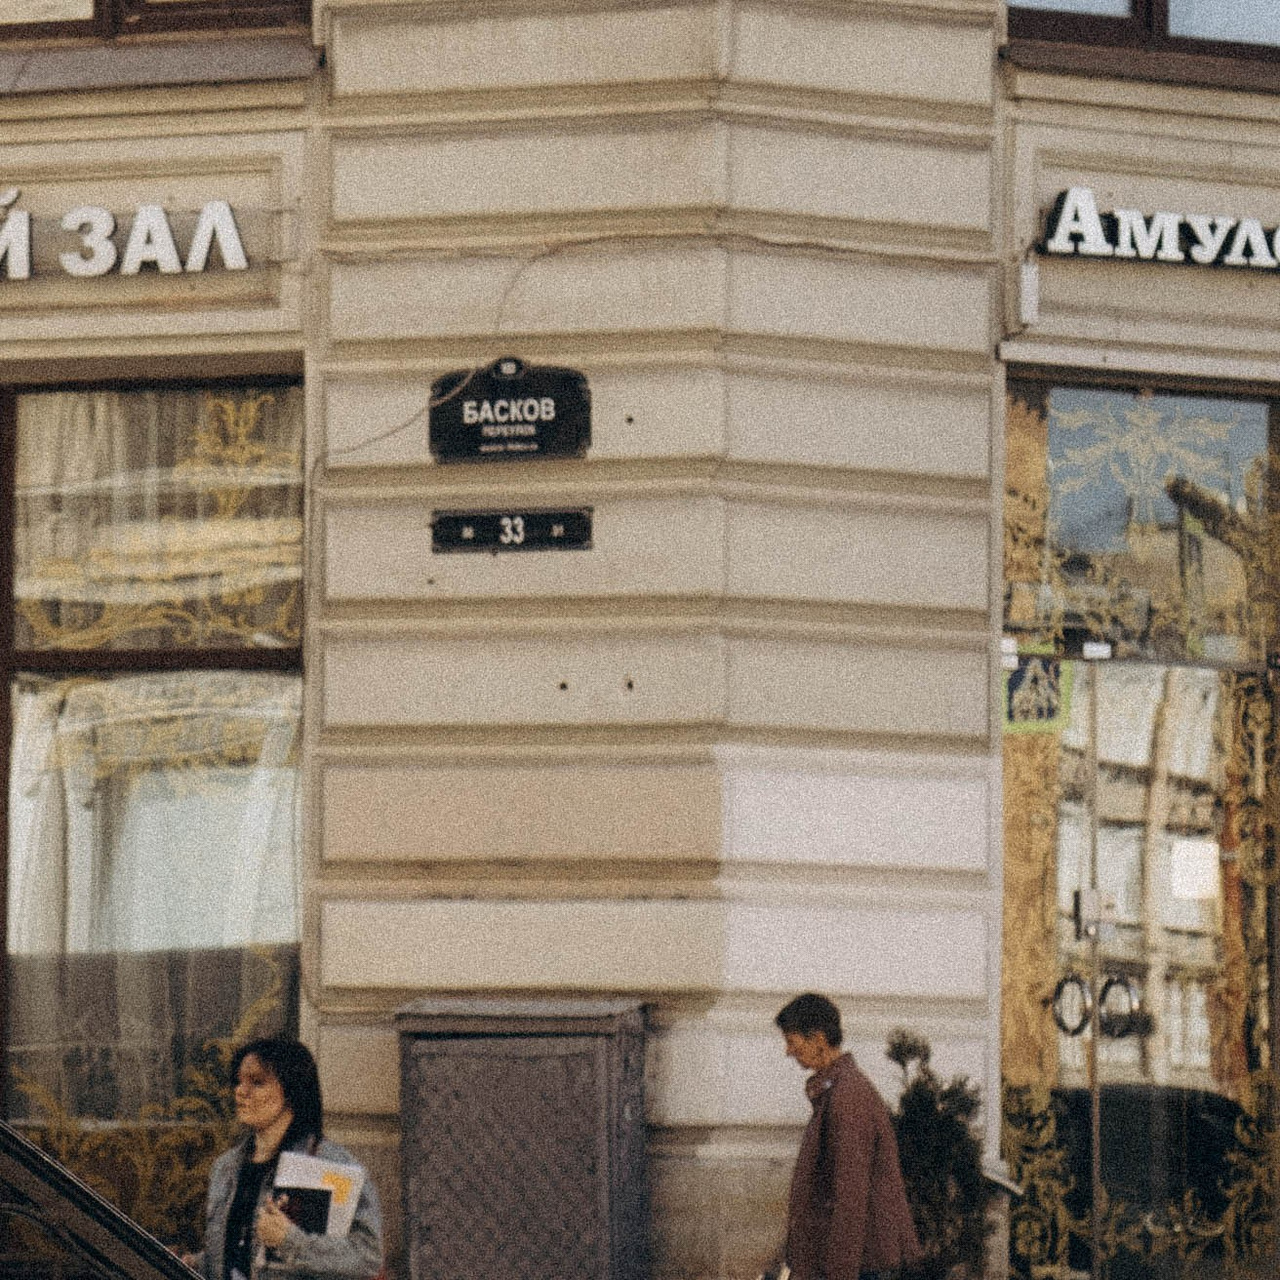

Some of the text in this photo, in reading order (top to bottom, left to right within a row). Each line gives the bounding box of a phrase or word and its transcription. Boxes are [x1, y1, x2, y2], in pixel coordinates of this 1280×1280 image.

[58, 199, 249, 278] ЗАЛ
[1046, 186, 1280, 268] Амул
[462, 397, 556, 424] БАСКОВ
[499, 516, 525, 544] 33
